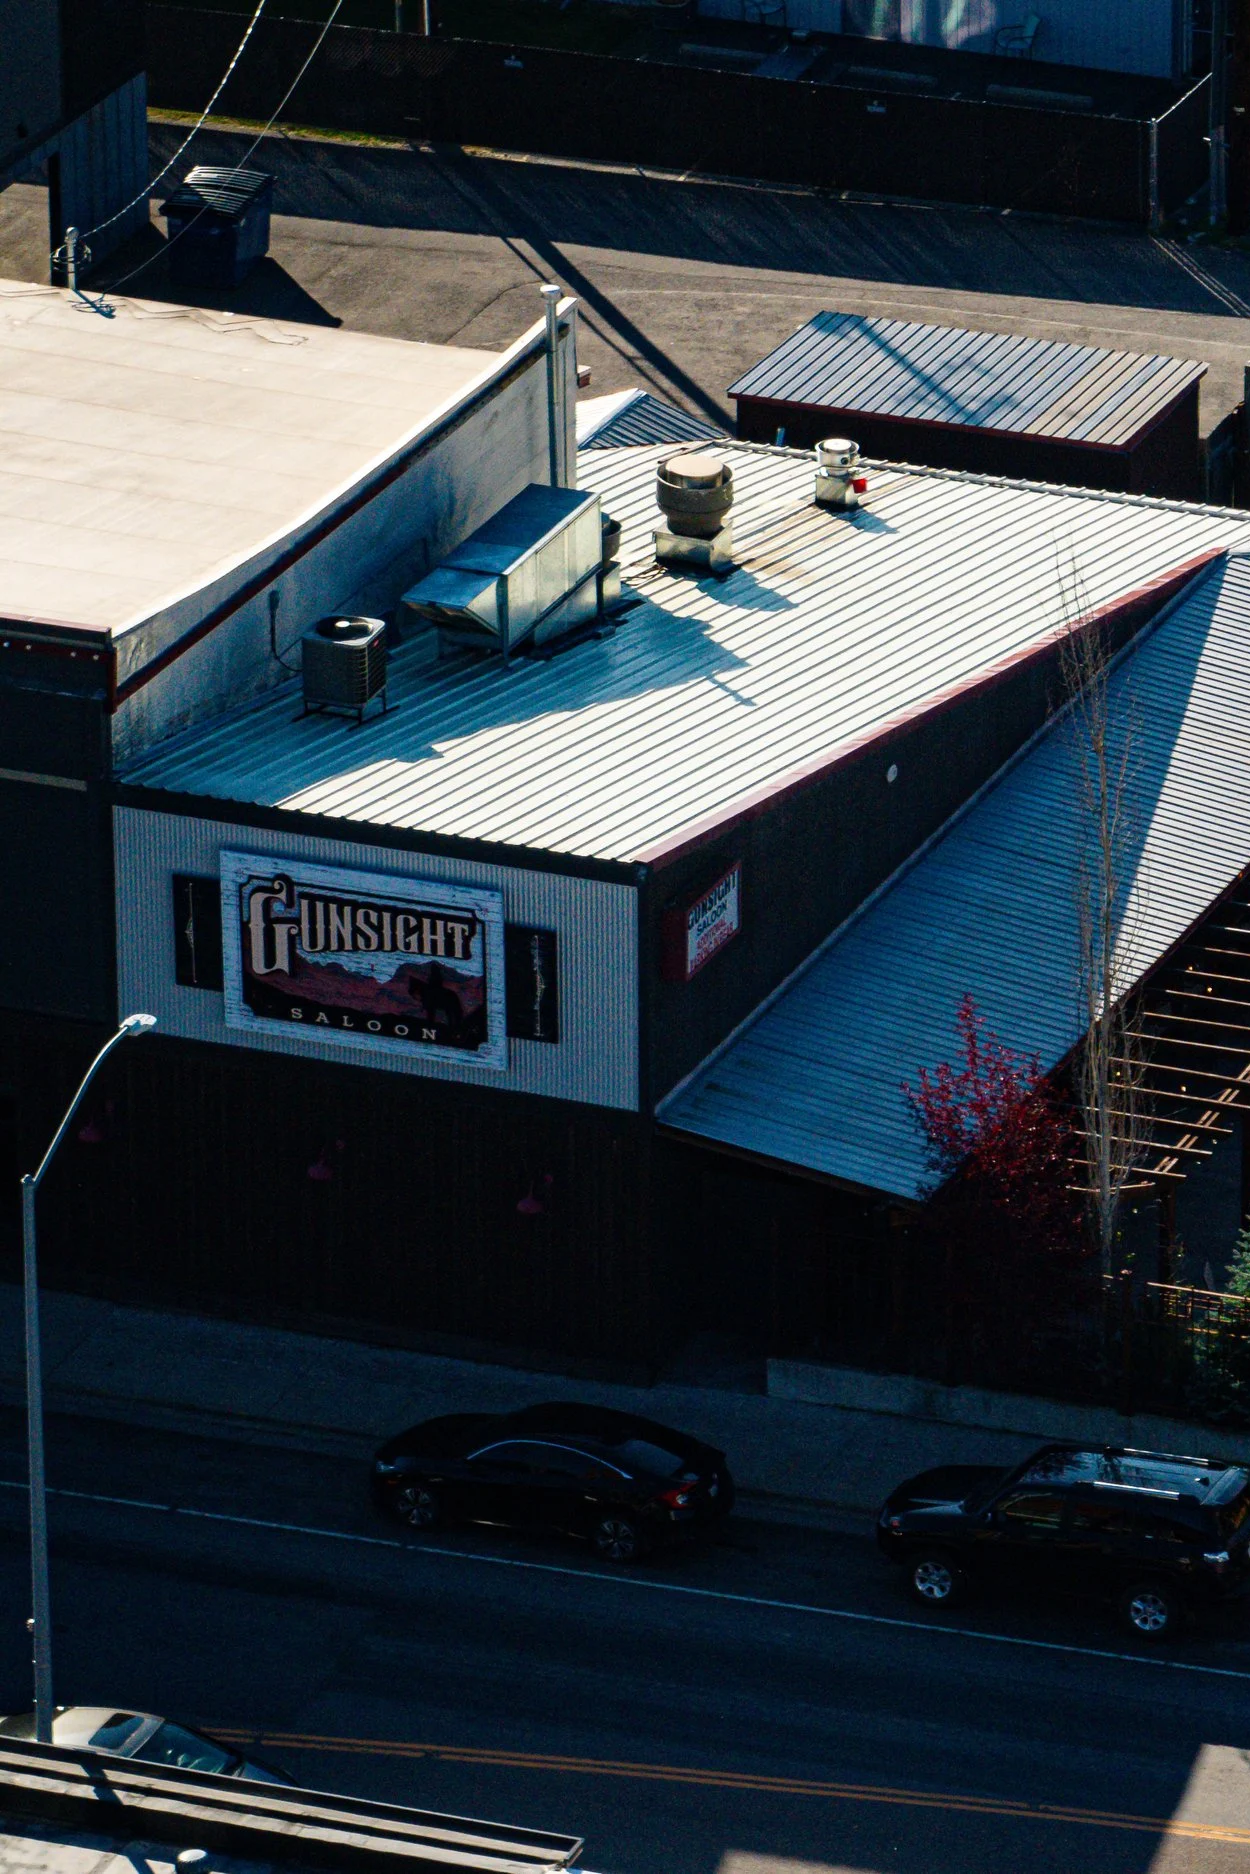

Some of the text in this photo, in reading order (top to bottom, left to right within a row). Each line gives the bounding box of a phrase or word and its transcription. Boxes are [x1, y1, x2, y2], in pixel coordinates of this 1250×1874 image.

[688, 870, 737, 930] GUNSIGHT
[697, 900, 728, 936] SALOON
[250, 879, 469, 976] GUNSIGHT
[290, 1007, 438, 1040] SALOON
